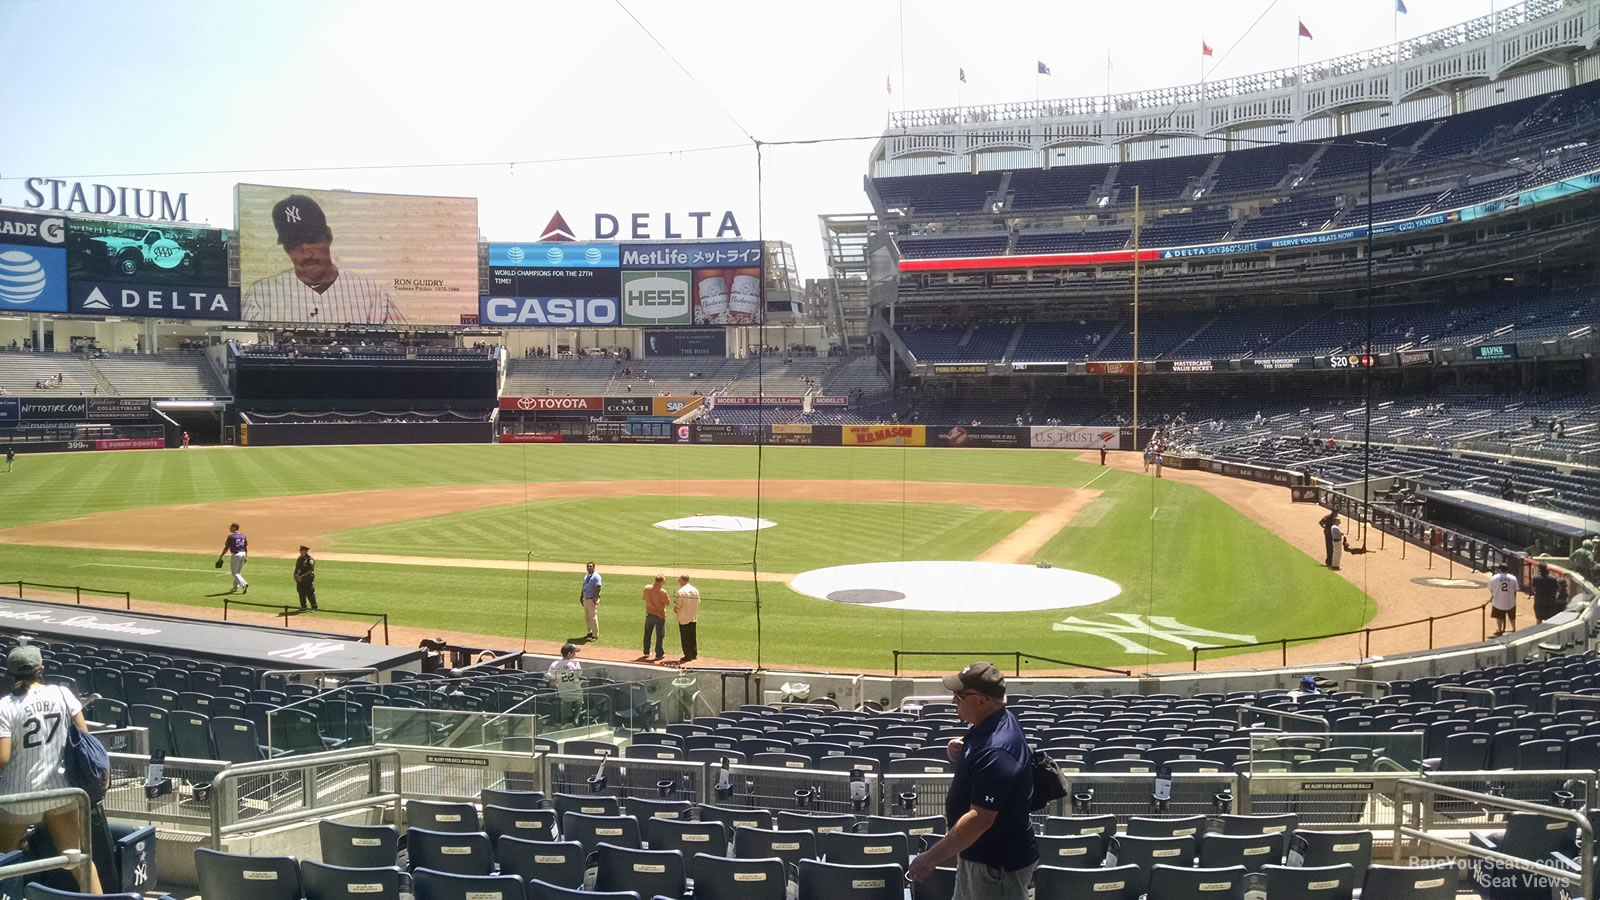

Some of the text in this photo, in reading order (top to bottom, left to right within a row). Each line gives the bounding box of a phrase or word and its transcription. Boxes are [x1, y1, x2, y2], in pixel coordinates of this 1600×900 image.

[24, 177, 189, 221] STADIUM
[594, 210, 742, 240] DELTA
[1416, 215, 1444, 228] YANKEES
[1271, 231, 1354, 248] RESERVE YOUR SEATS NOW!
[622, 246, 760, 266] MetLife メットライフ
[1174, 249, 1205, 257] DELTA
[121, 290, 229, 311] DELTA
[628, 290, 685, 306] HESS
[486, 298, 616, 323] CASIO
[1487, 346, 1503, 354] LYNX
[1330, 356, 1348, 368] $20
[538, 399, 588, 409] TOYOTA
[667, 402, 684, 411] SAP
[875, 427, 913, 440] MASON
[1035, 432, 1094, 442] U.S. TRUST
[1501, 583, 1508, 592] 2
[561, 672, 575, 682] 22
[24, 701, 55, 716] STORY
[23, 713, 61, 748] 27
